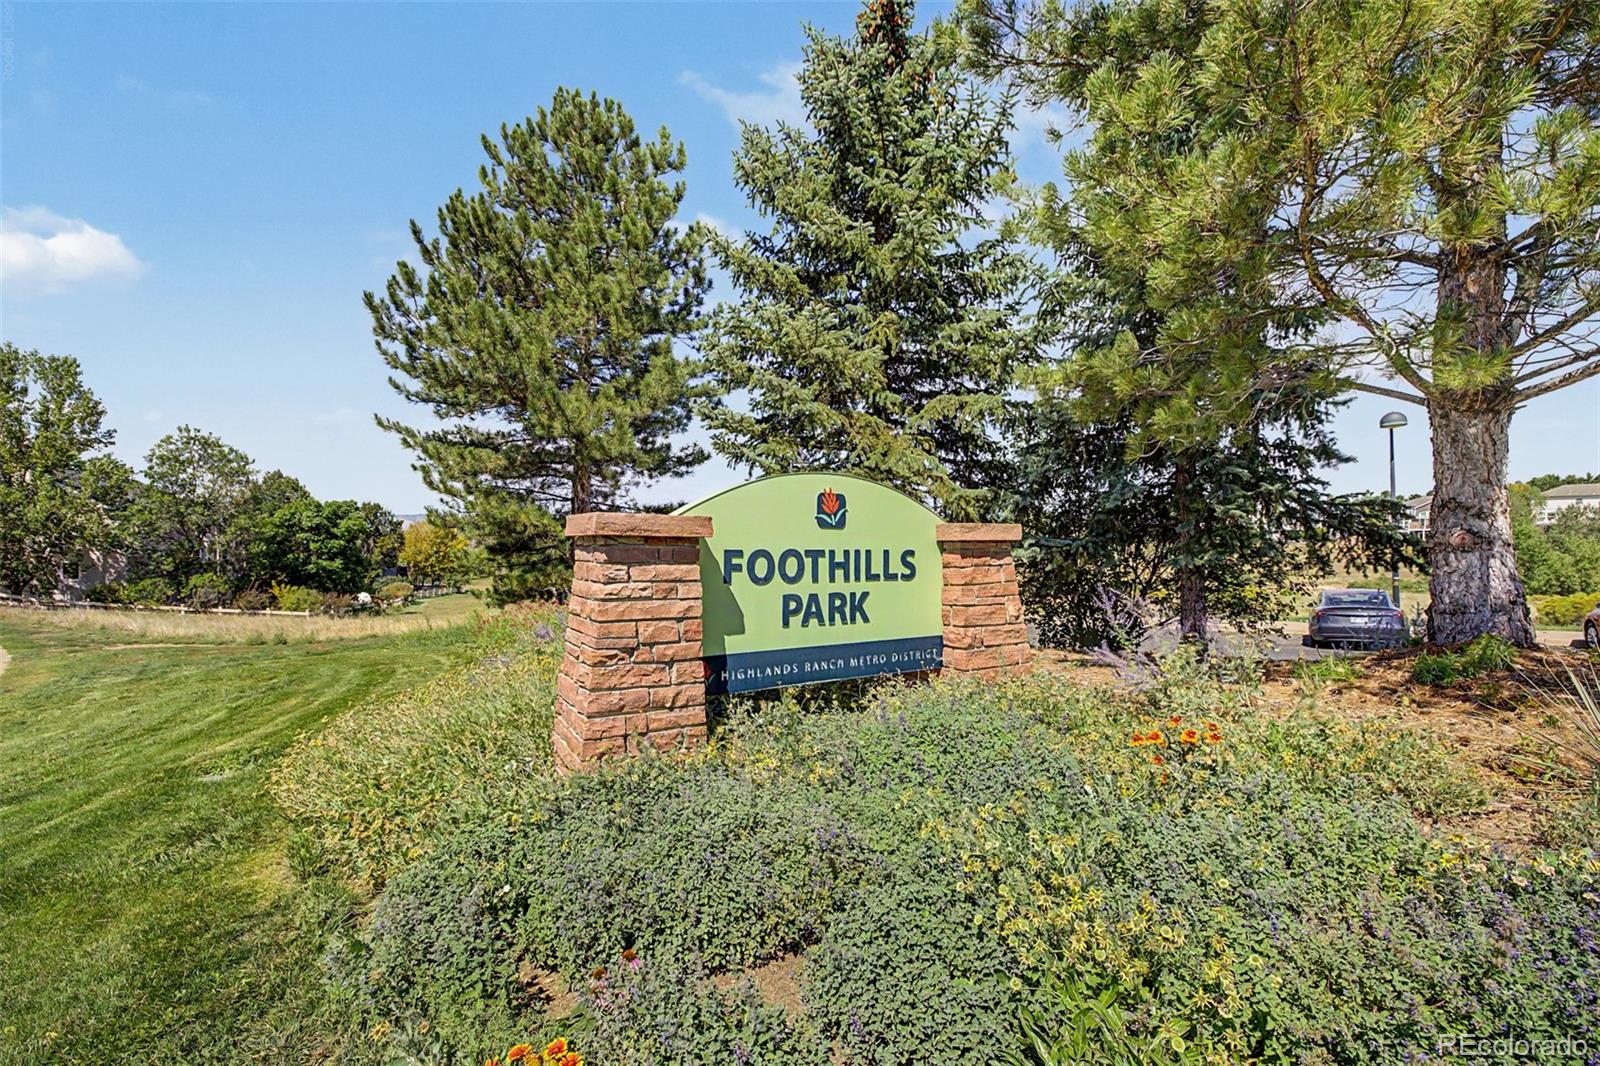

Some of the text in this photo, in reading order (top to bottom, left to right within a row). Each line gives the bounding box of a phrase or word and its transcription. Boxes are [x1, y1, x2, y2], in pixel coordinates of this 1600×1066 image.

[723, 548, 917, 586] FOOTHILLS
[782, 591, 870, 629] PARK
[721, 647, 939, 681] HIGHLANDS RANCH METRO DISTRICT
